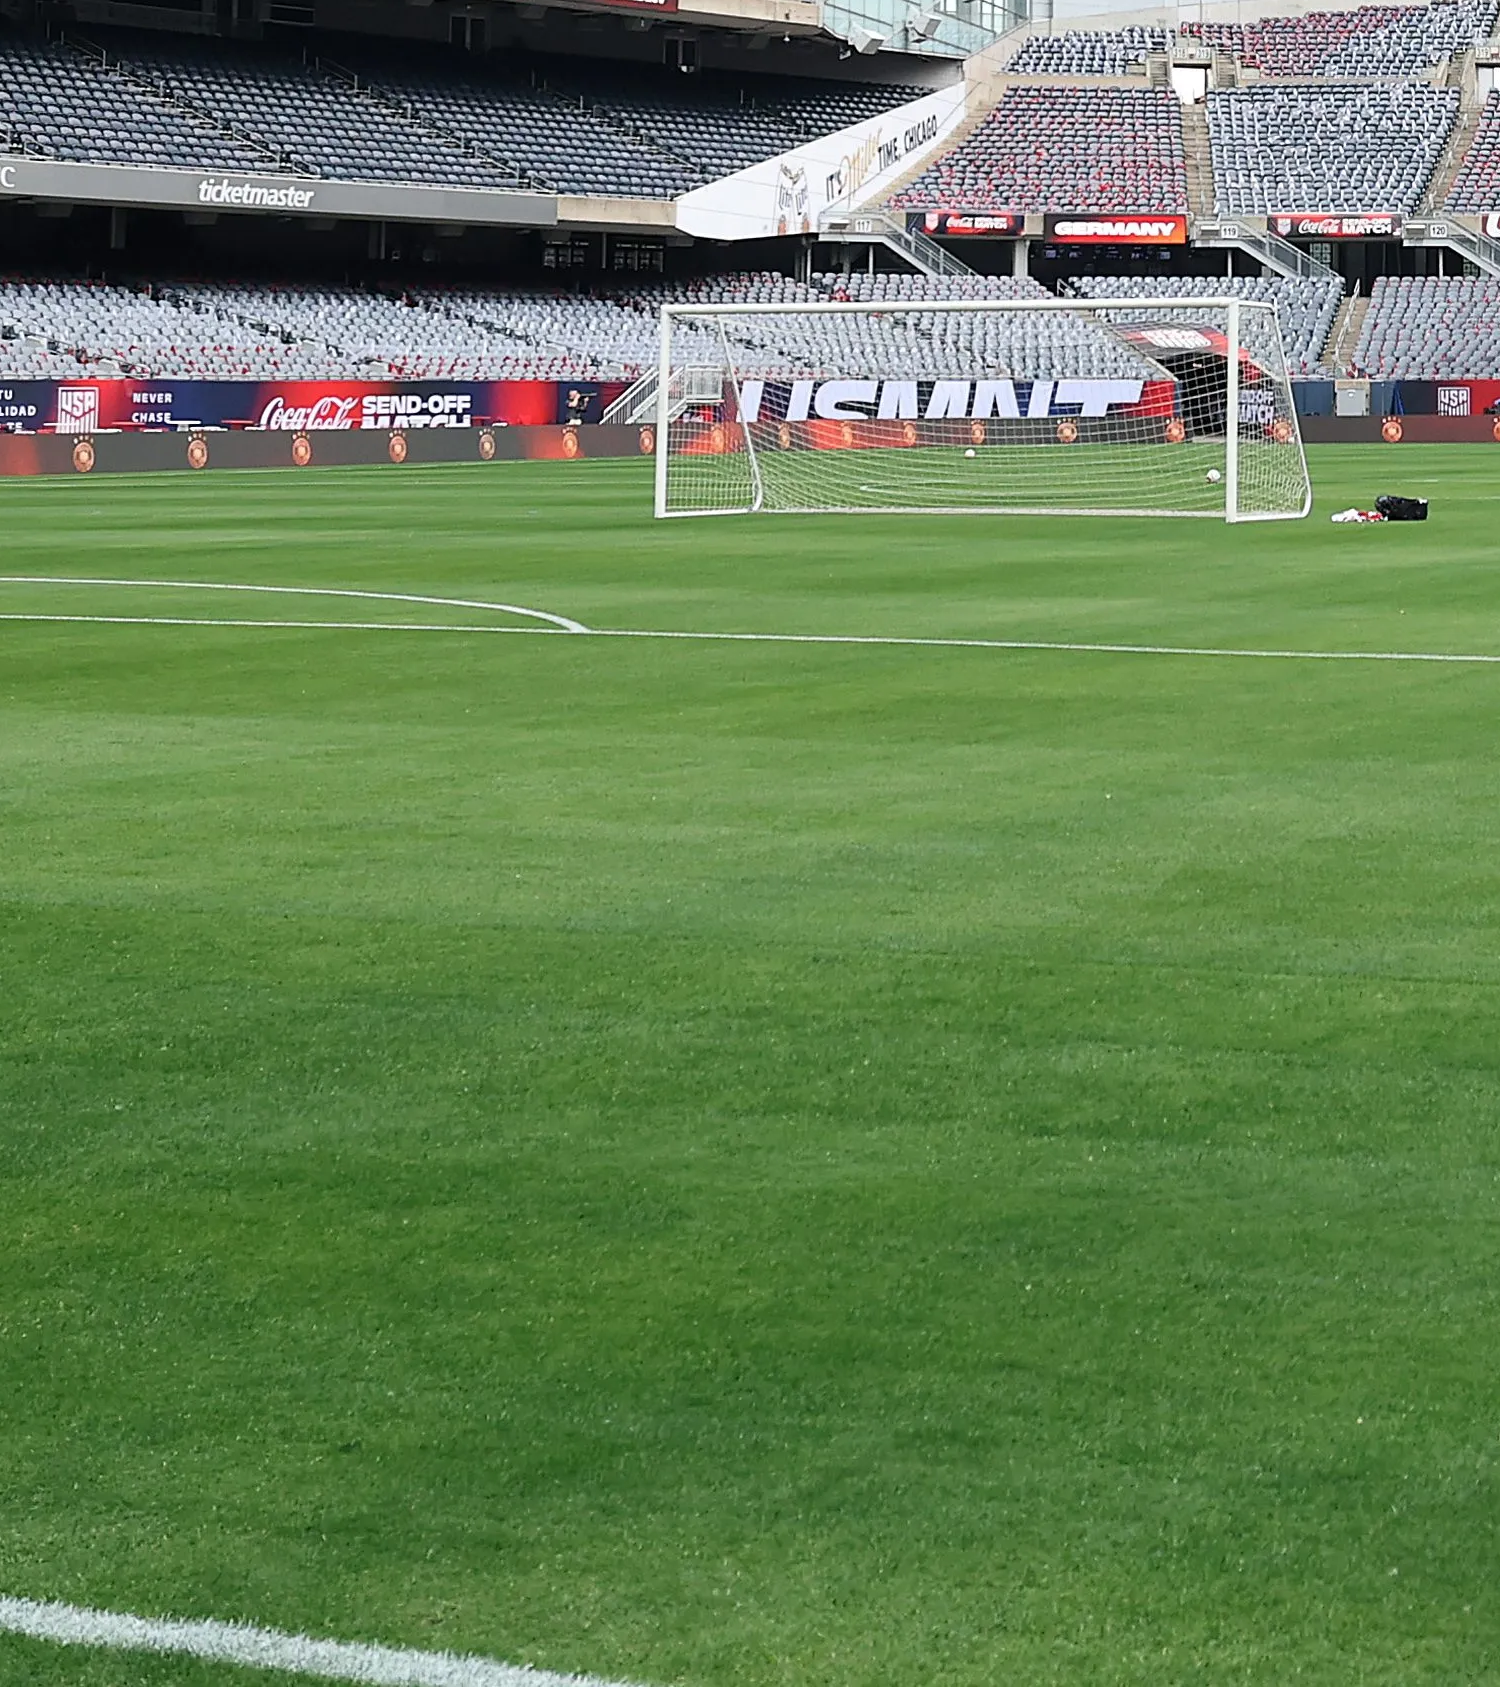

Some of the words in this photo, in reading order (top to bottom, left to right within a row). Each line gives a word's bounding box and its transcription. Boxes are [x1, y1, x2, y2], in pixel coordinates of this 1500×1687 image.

[826, 169, 842, 202] IT'S
[904, 115, 938, 155] CHICAGO
[198, 178, 315, 208] ticketmaster
[1054, 220, 1175, 237] GERMANY
[1223, 226, 1236, 235] 119
[1297, 219, 1341, 234] Coca-Cola
[1342, 224, 1392, 235] MATCH
[1432, 226, 1445, 235] 120
[61, 391, 95, 416] USA
[132, 392, 172, 404] NEVER
[361, 395, 472, 414] SEND-OFF
[1440, 390, 1467, 407] USA
[132, 411, 172, 423] CHASE
[260, 396, 359, 430] Coca-Cola
